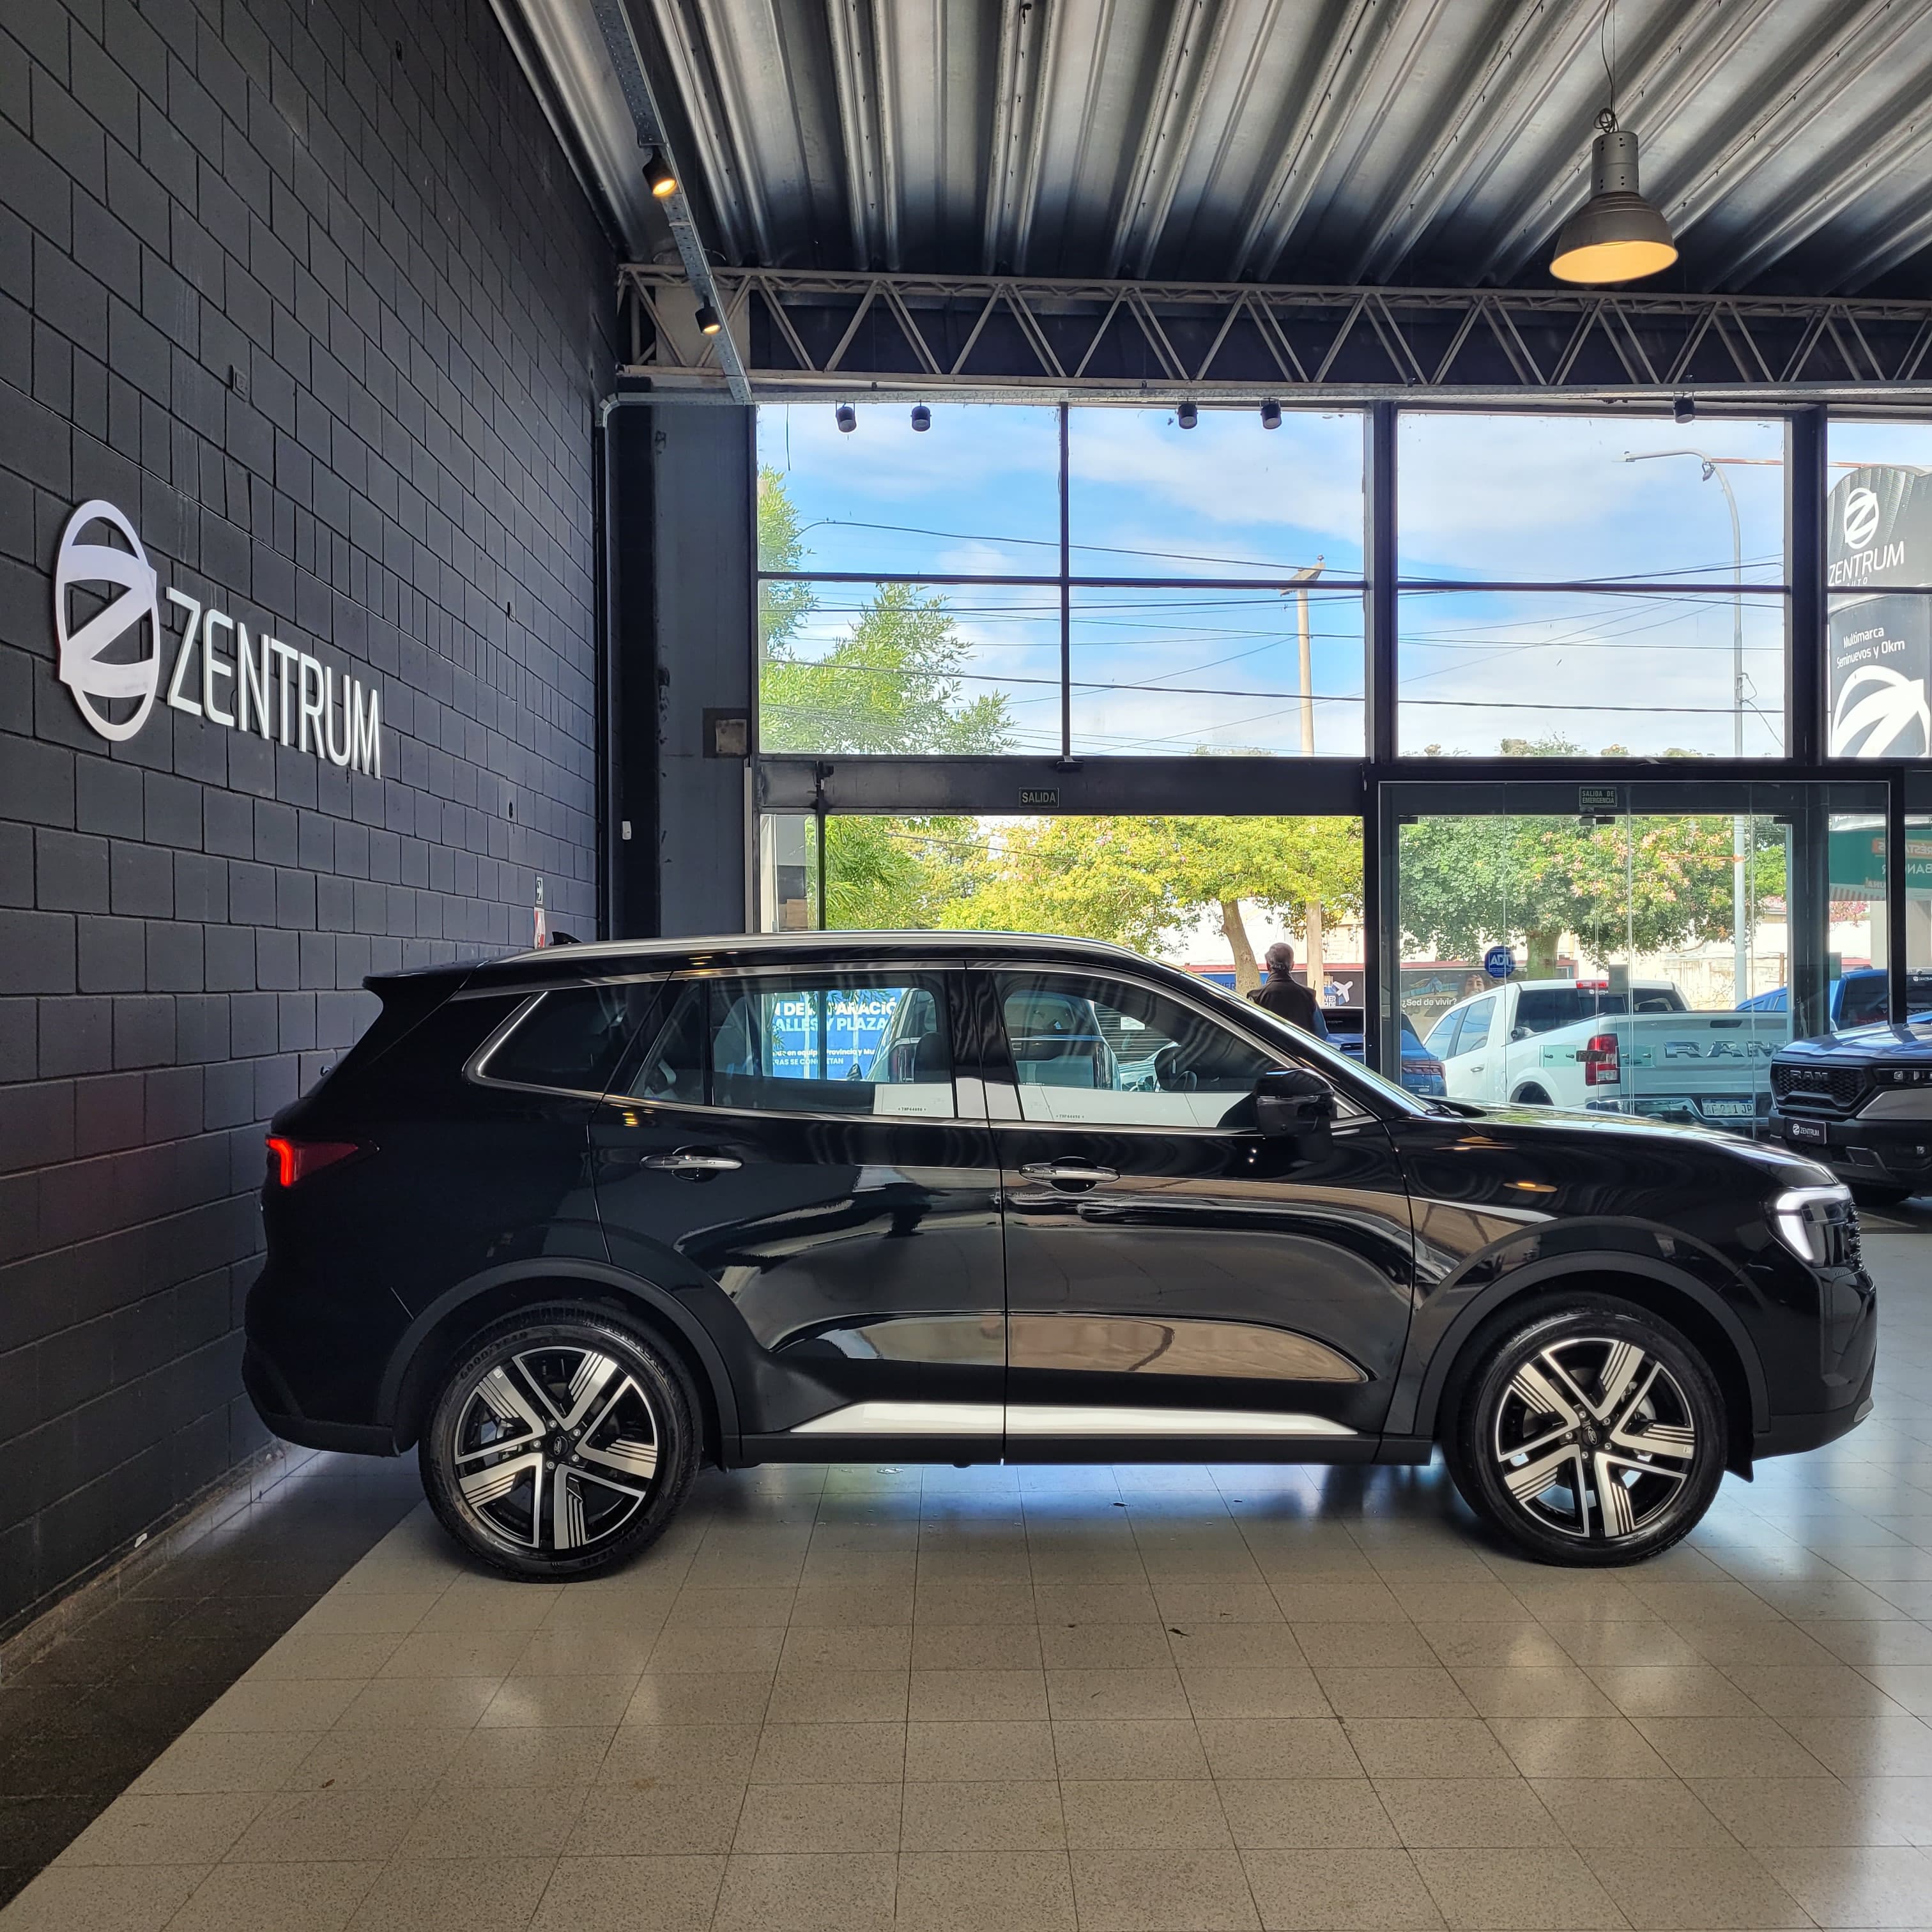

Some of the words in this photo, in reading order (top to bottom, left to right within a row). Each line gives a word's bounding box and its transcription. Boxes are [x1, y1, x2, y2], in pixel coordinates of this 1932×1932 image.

[1828, 541, 1905, 586] ZENTRUM
[1847, 576, 1868, 586] UTO
[1843, 627, 1884, 649] Multimarca
[1836, 648, 1871, 669] Seminuevos
[1873, 645, 1879, 659] y
[165, 586, 381, 779] ZENTRUM
[1022, 792, 1056, 803] SALIDA
[784, 1002, 805, 1016] DE
[1402, 999, 1422, 1008] ¿Sed
[772, 1018, 818, 1031] ALLES
[836, 1016, 888, 1031] PLAZA
[1790, 1070, 1828, 1081] RAM
